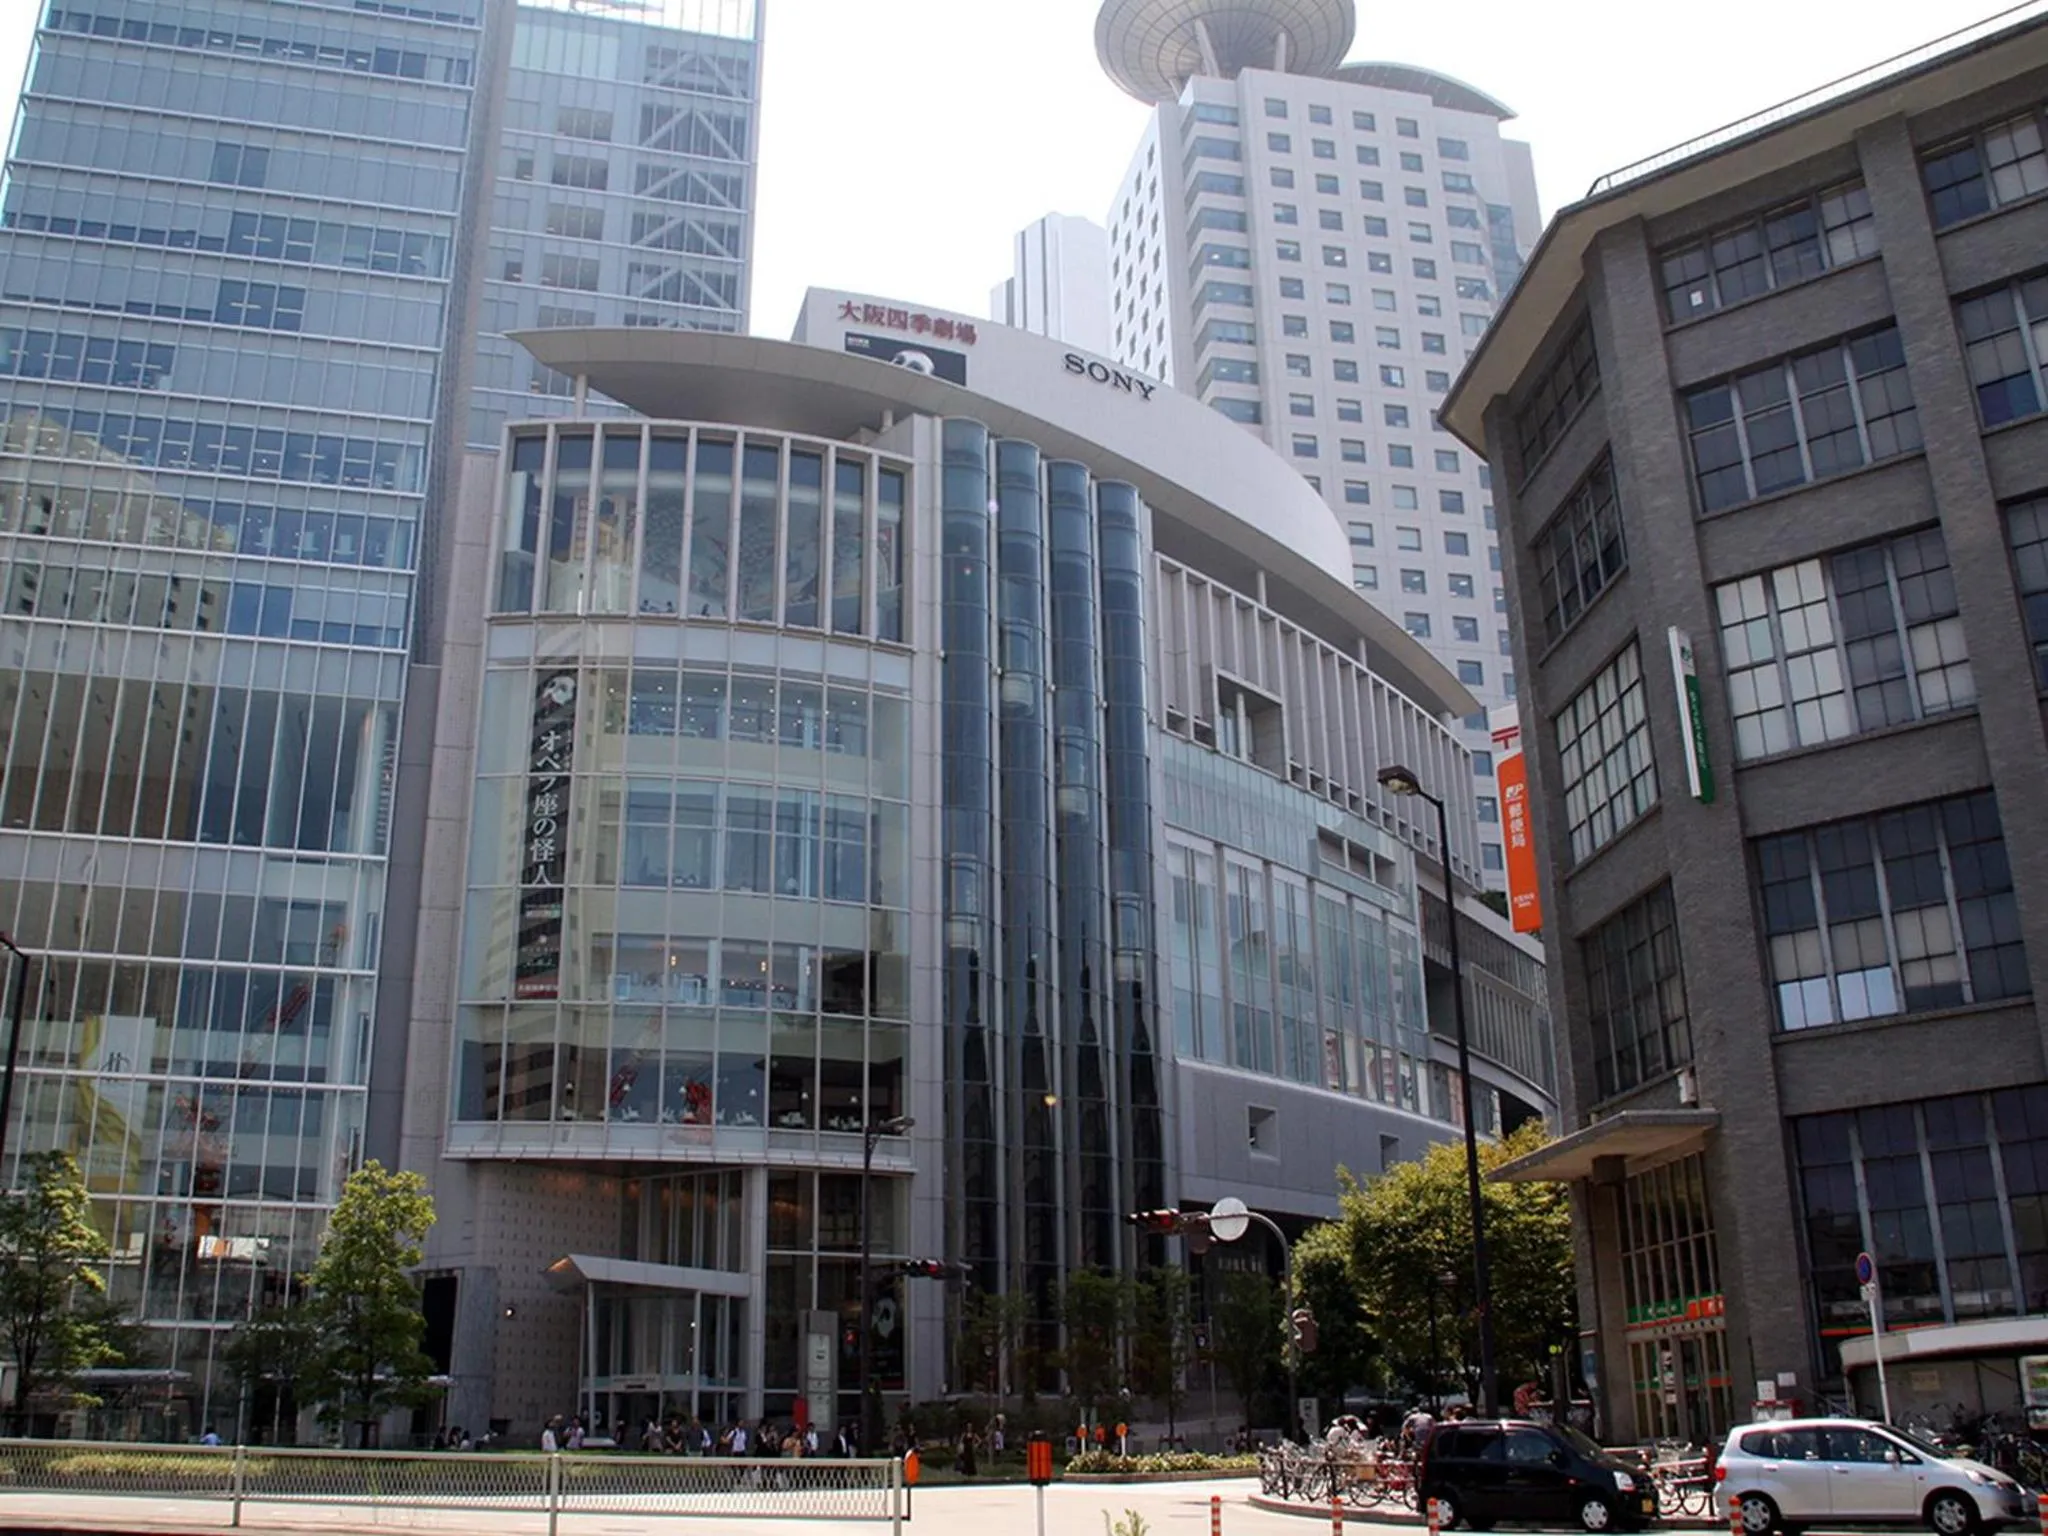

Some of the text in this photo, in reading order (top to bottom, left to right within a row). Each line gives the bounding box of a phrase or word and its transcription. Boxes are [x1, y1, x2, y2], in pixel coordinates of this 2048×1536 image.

[837, 300, 977, 346] 大阪四季劇場
[1064, 353, 1155, 400] SONY
[530, 730, 561, 886] オペラ座の怪人
